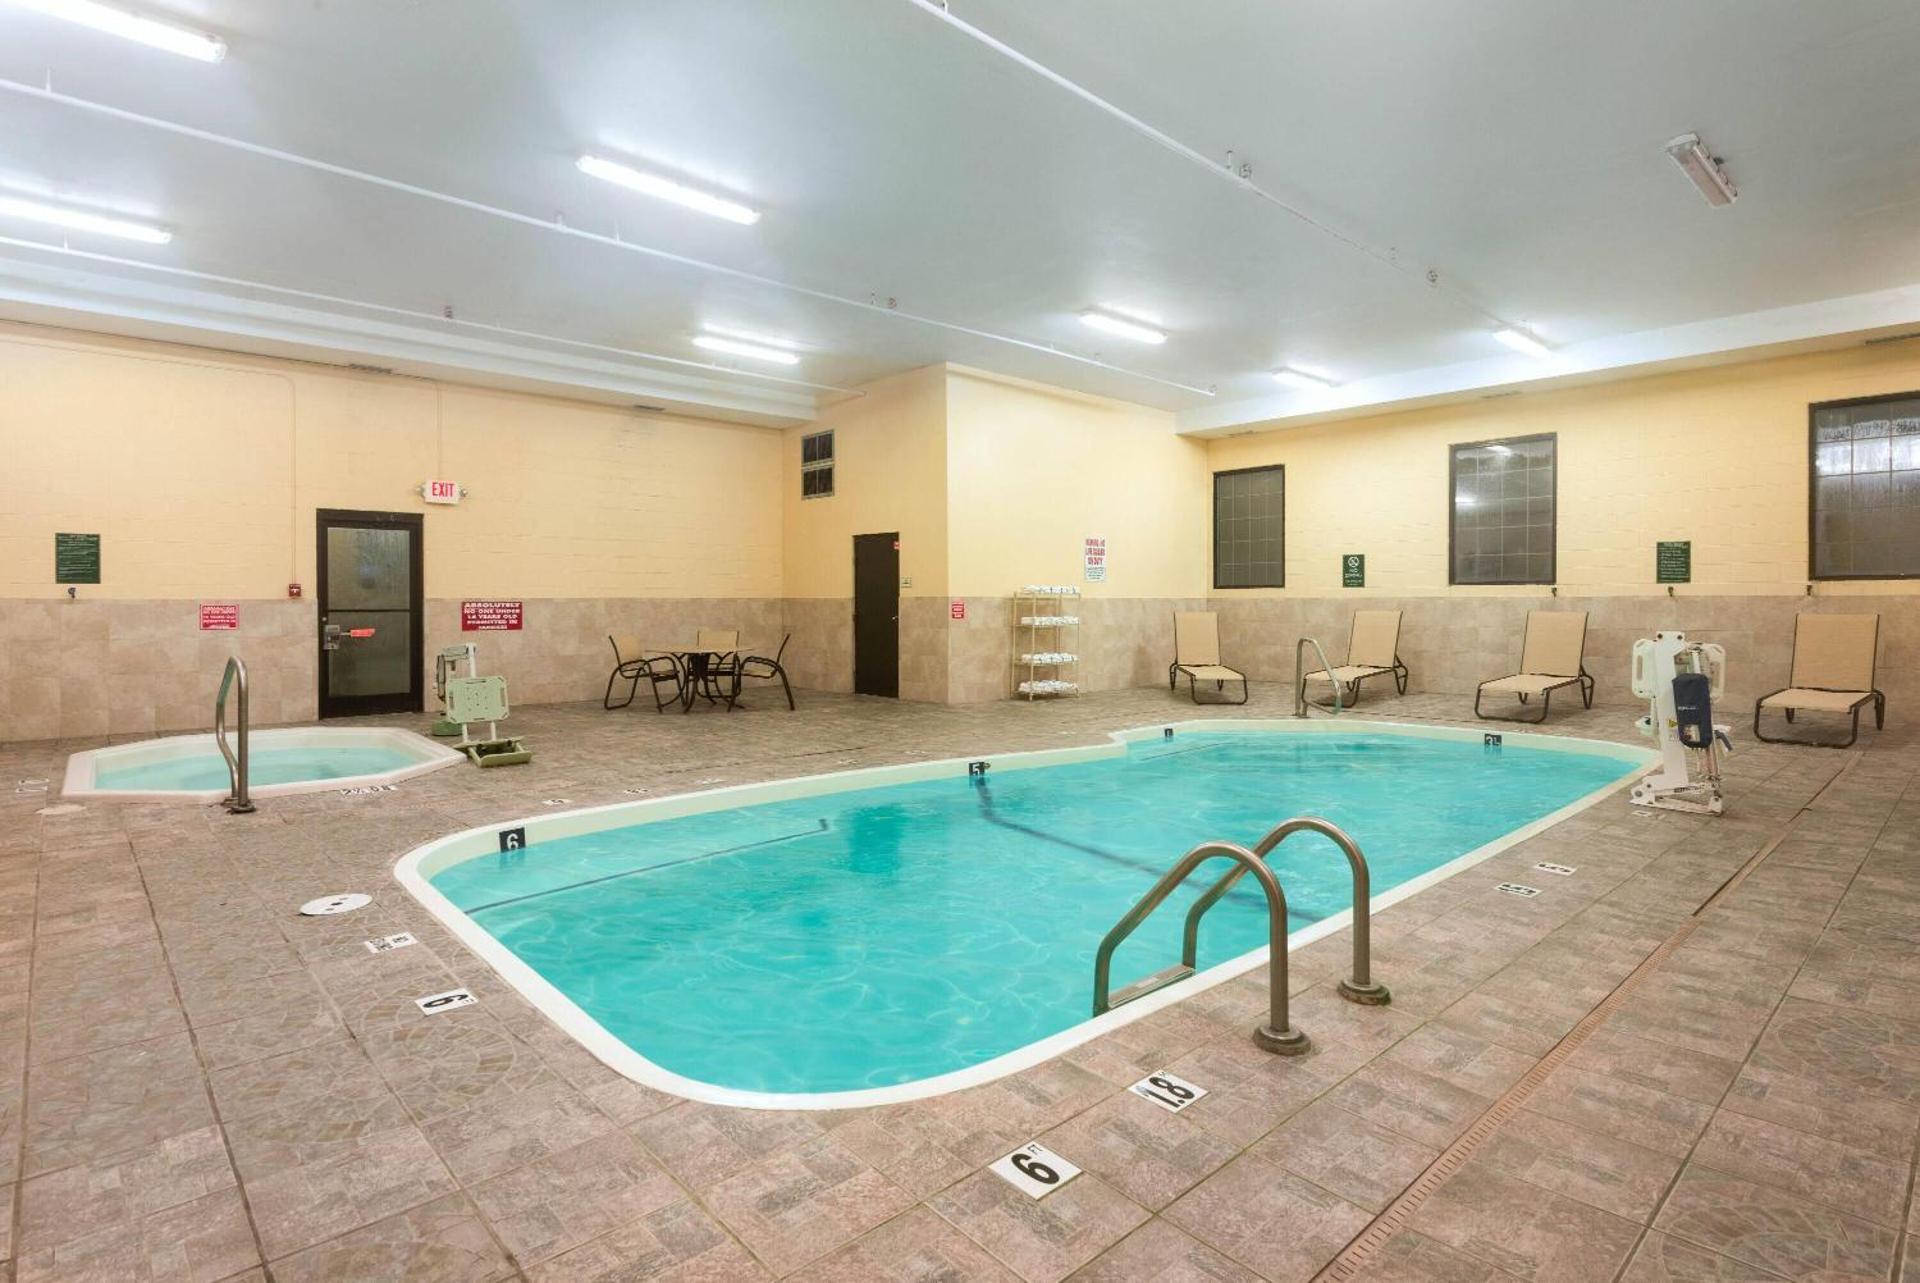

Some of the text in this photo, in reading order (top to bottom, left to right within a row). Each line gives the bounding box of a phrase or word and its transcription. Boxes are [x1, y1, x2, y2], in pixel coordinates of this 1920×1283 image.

[432, 482, 456, 497] EXIT
[506, 833, 519, 850] 6
[1136, 1076, 1195, 1109] 1.8
[1010, 1153, 1060, 1185] 6
